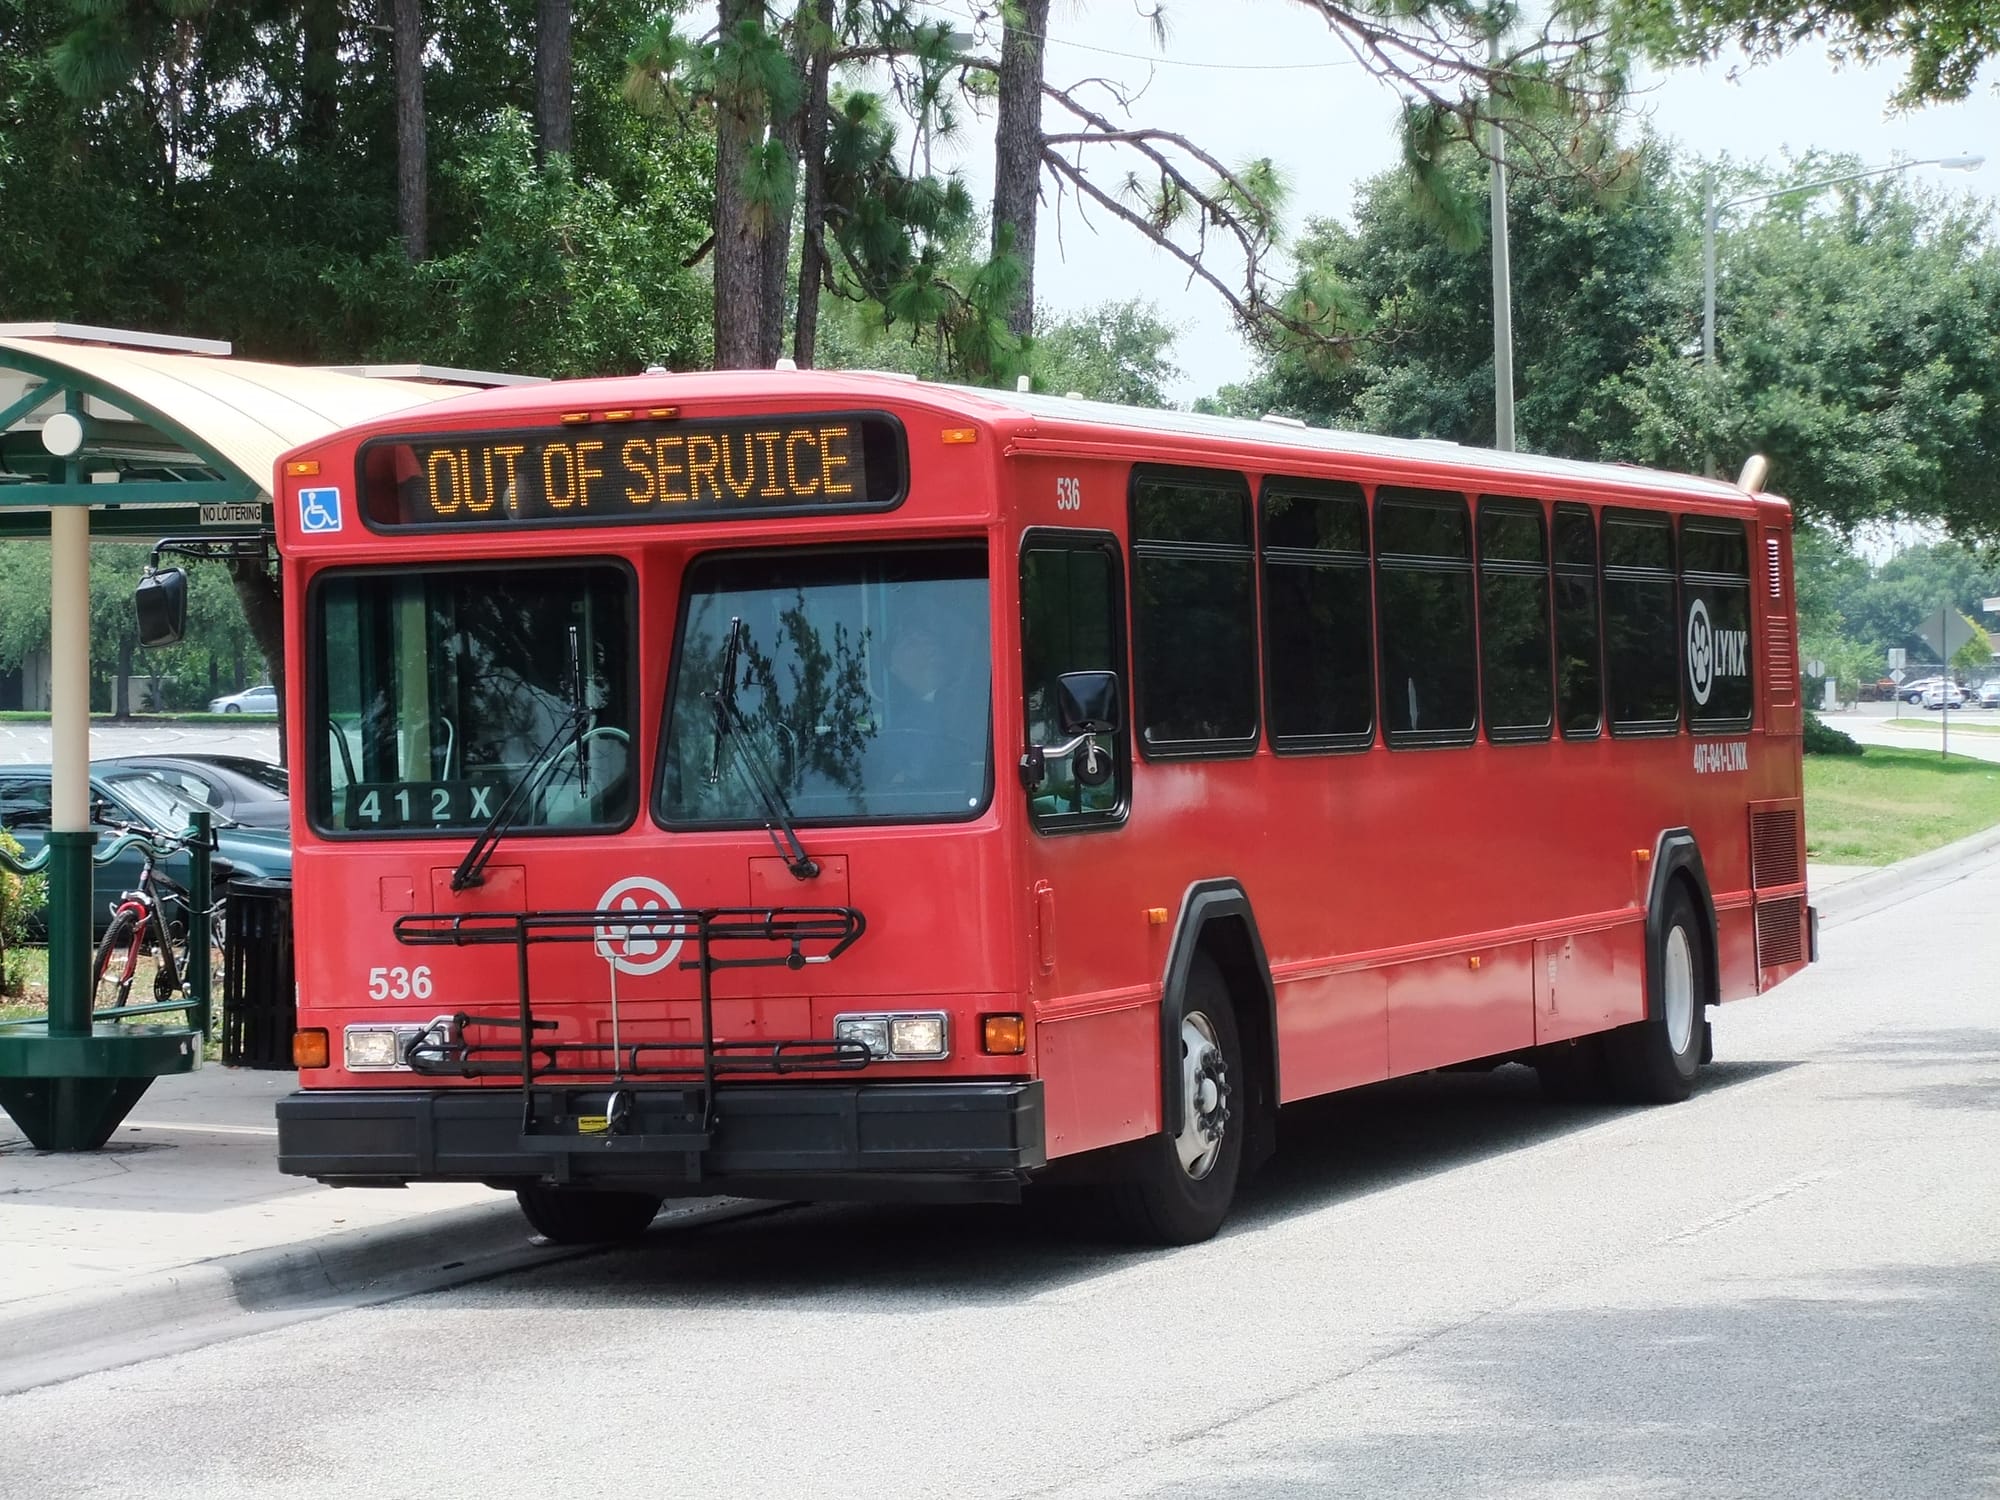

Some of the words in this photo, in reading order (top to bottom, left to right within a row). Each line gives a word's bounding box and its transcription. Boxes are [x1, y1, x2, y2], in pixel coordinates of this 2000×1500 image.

[427, 444, 525, 514] OUT
[542, 441, 604, 508] OF
[621, 427, 853, 504] SERVICE
[1057, 477, 1081, 510] 536
[202, 507, 215, 521] NO
[217, 506, 261, 521] LOITERING
[1714, 629, 1747, 677] LYNX
[1693, 742, 1748, 774] 407-841-LYNX
[368, 965, 433, 1001] 536
